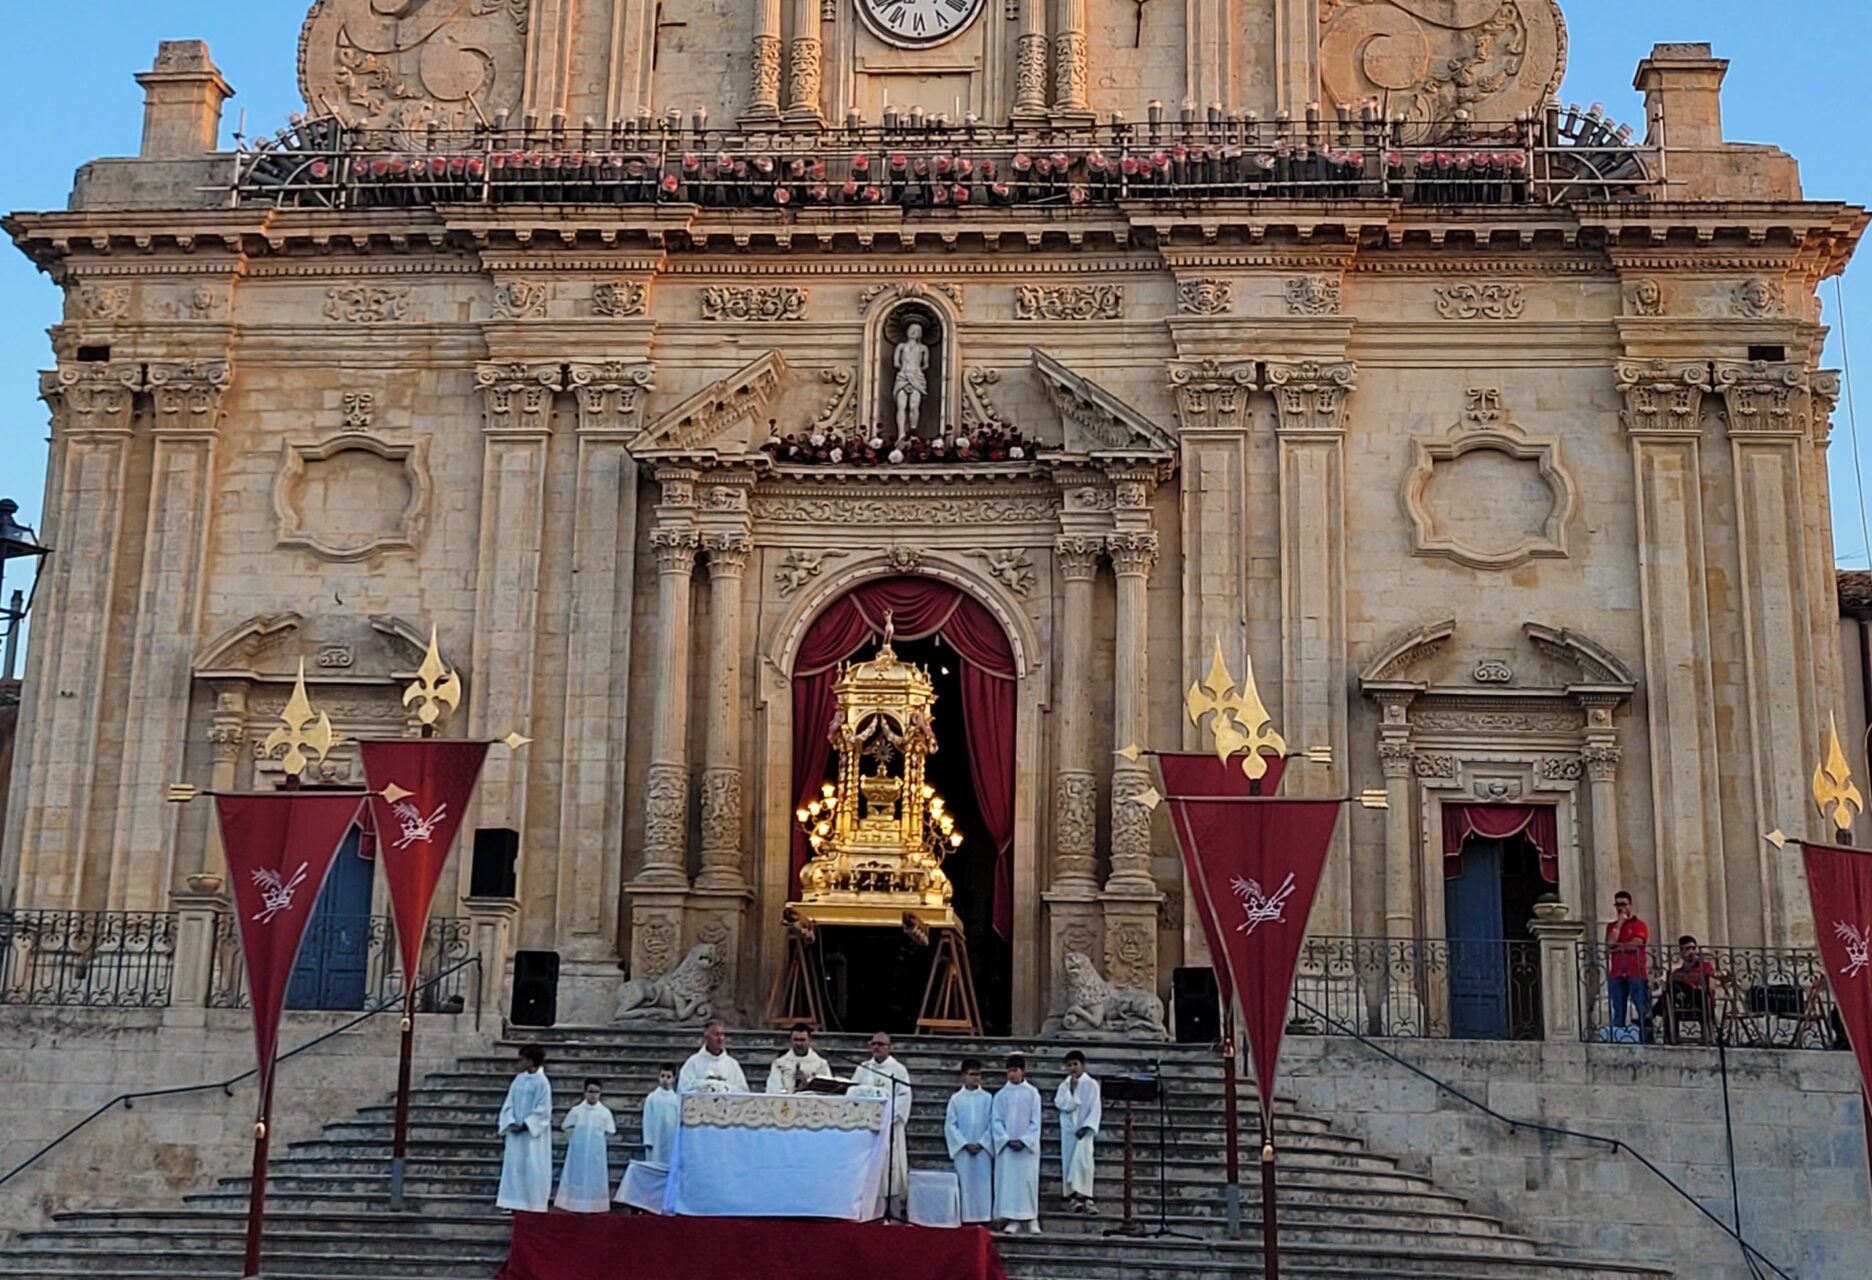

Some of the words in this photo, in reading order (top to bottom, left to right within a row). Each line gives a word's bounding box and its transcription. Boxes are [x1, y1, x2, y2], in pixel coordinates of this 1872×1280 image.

[889, 6, 906, 28] VII
[913, 12, 926, 31] VI
[936, 10, 949, 27] V
